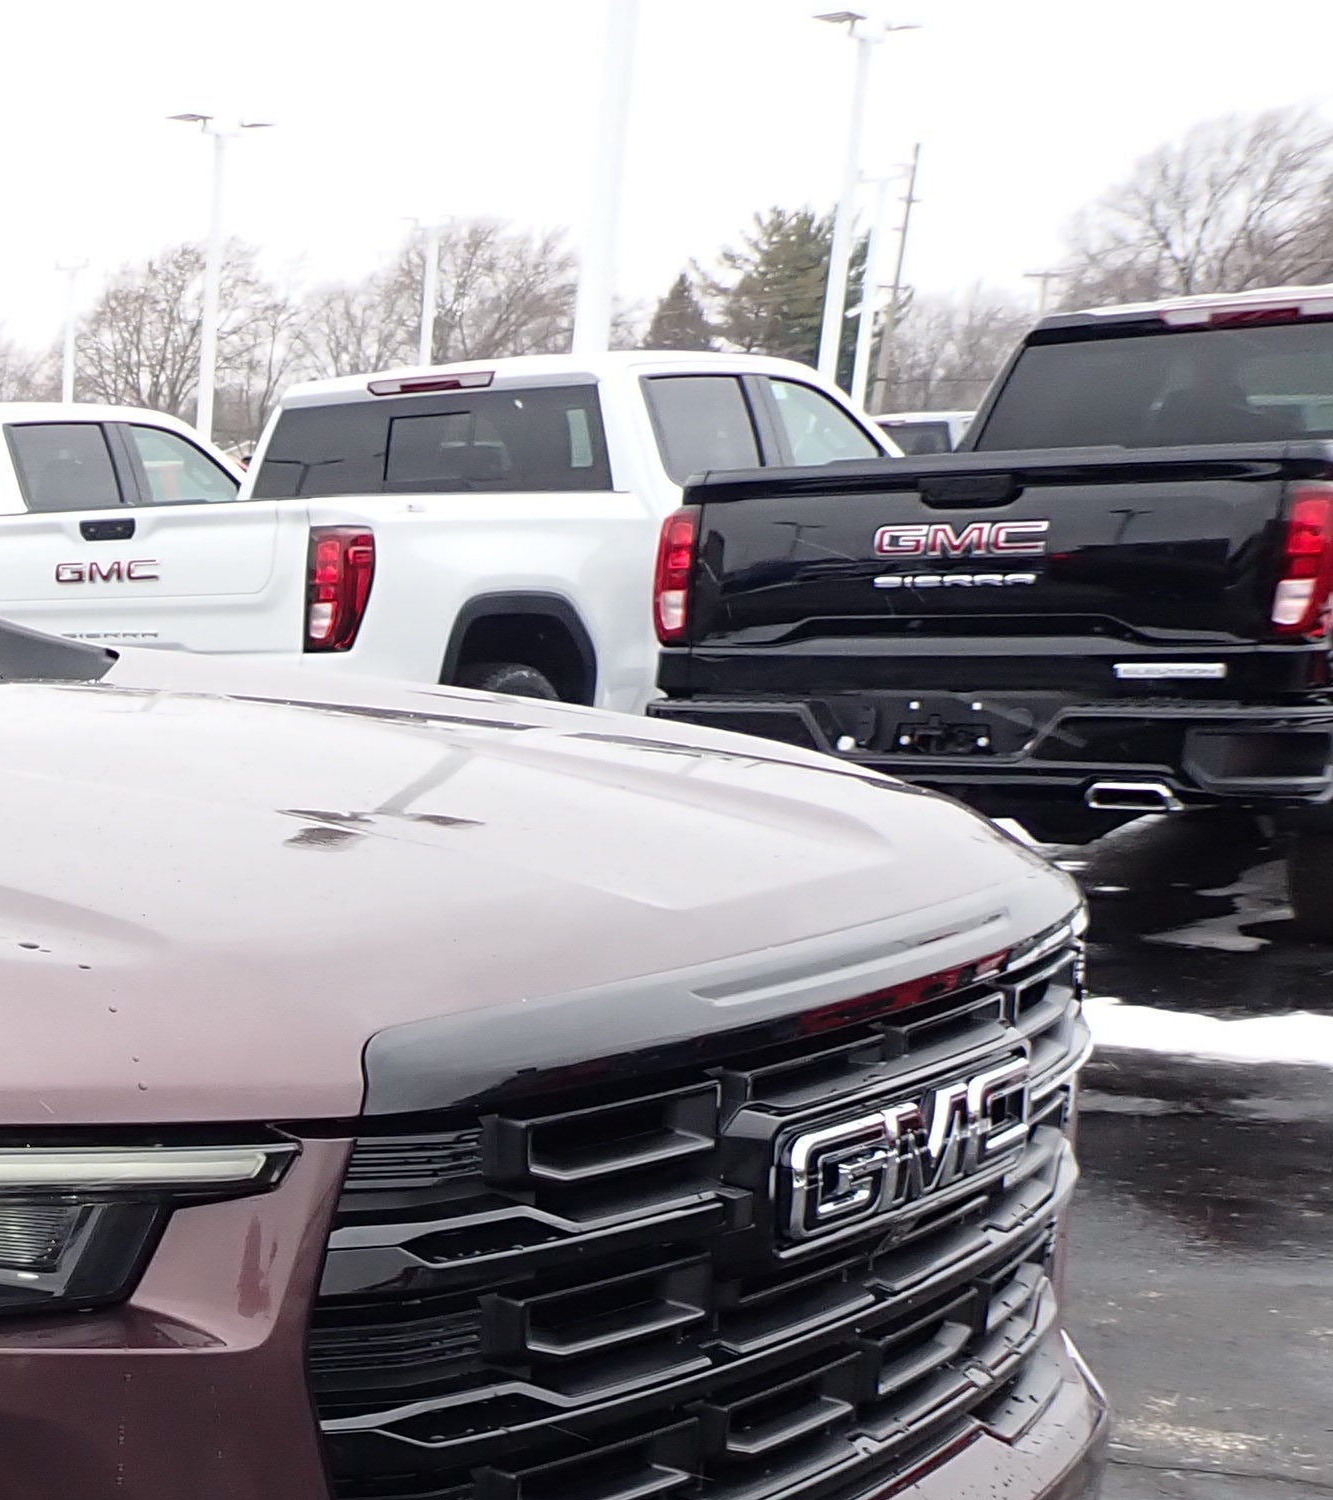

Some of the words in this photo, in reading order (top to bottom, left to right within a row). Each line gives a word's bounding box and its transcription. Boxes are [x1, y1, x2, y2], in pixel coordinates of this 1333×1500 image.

[873, 520, 1051, 558] GMC
[55, 559, 160, 584] GMC
[873, 573, 1037, 588] SIERRA
[789, 1057, 1031, 1240] GMC
